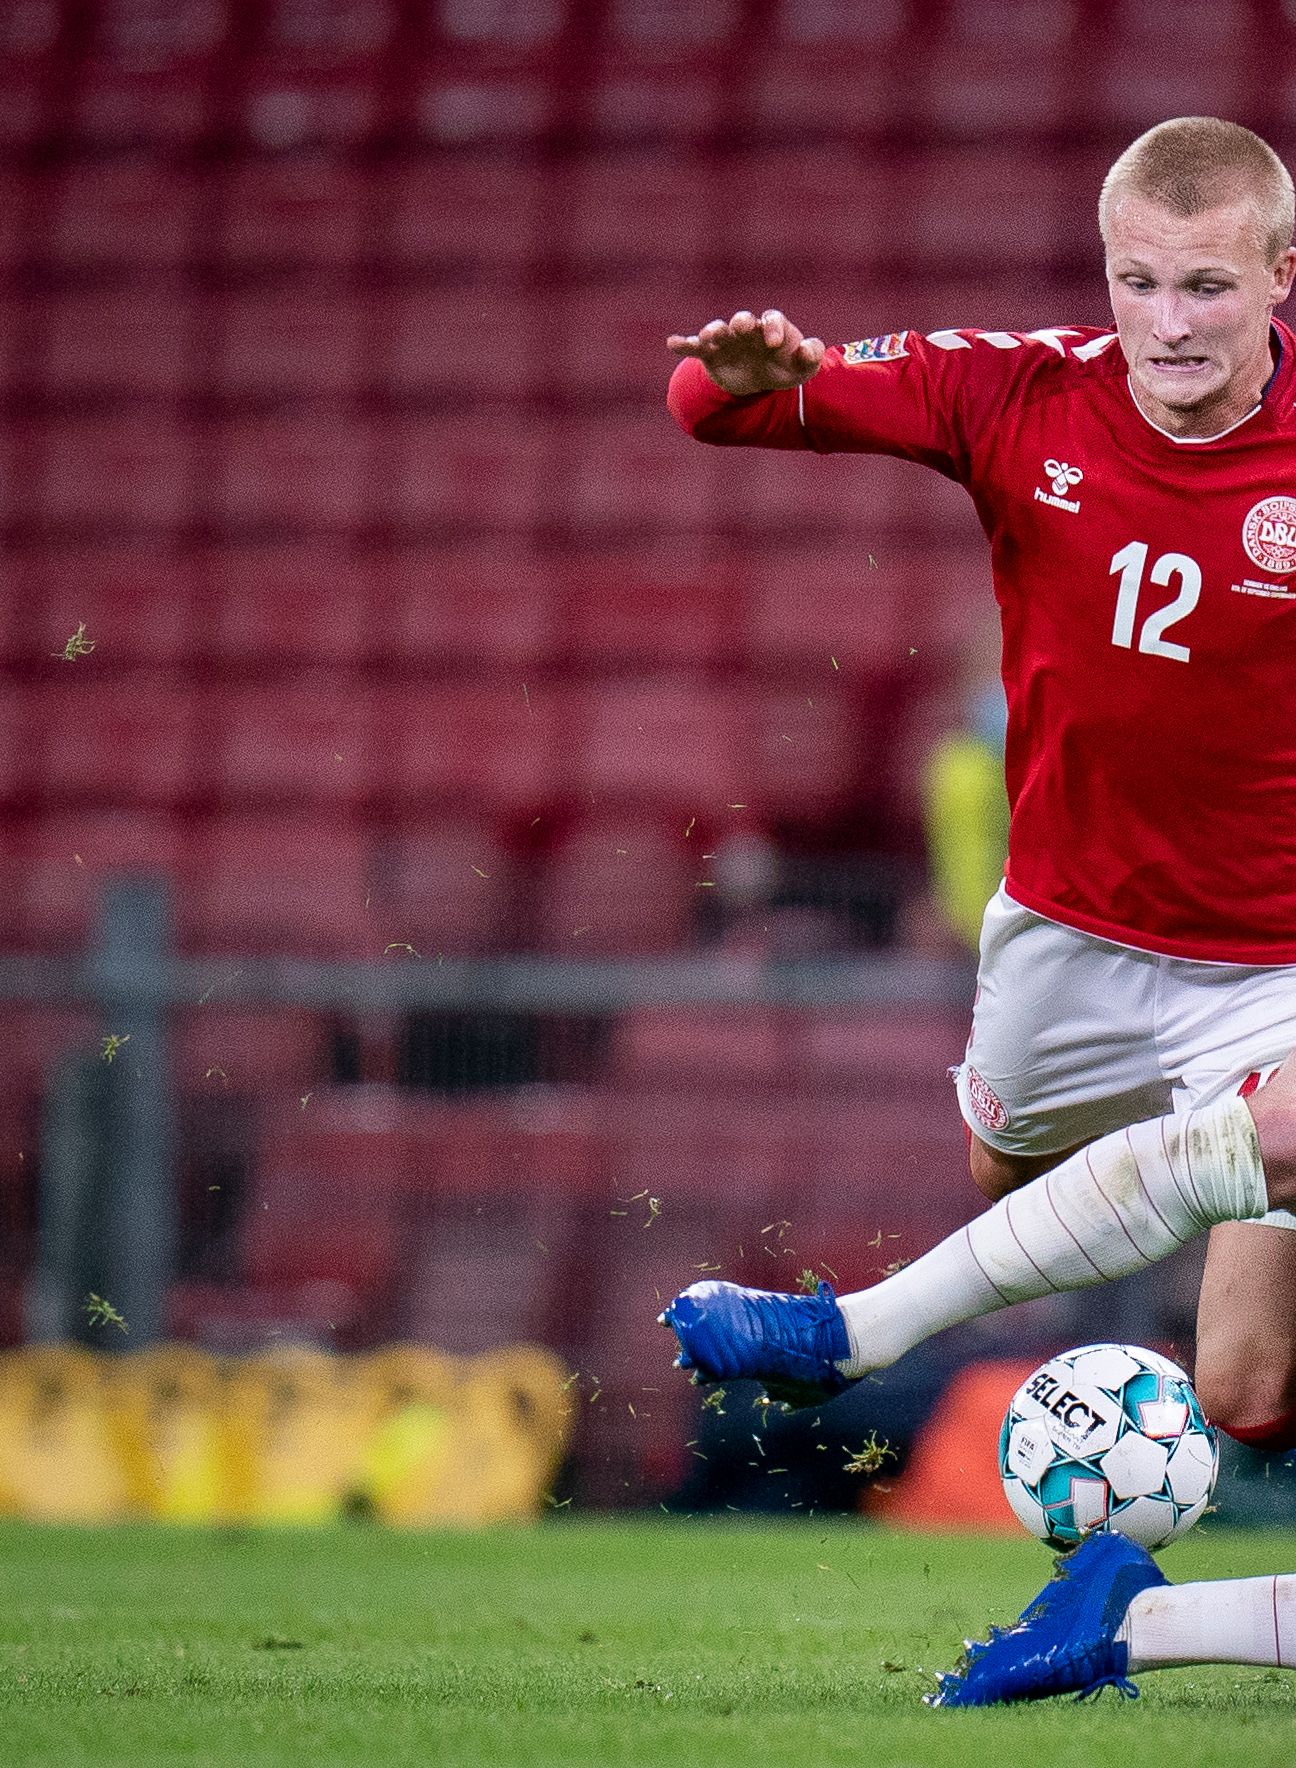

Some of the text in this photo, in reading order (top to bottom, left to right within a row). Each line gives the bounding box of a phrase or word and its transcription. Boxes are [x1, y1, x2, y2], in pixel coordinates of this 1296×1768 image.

[1034, 486, 1081, 514] hummel
[1109, 540, 1202, 664] 12
[1026, 1373, 1107, 1439] SELECT
